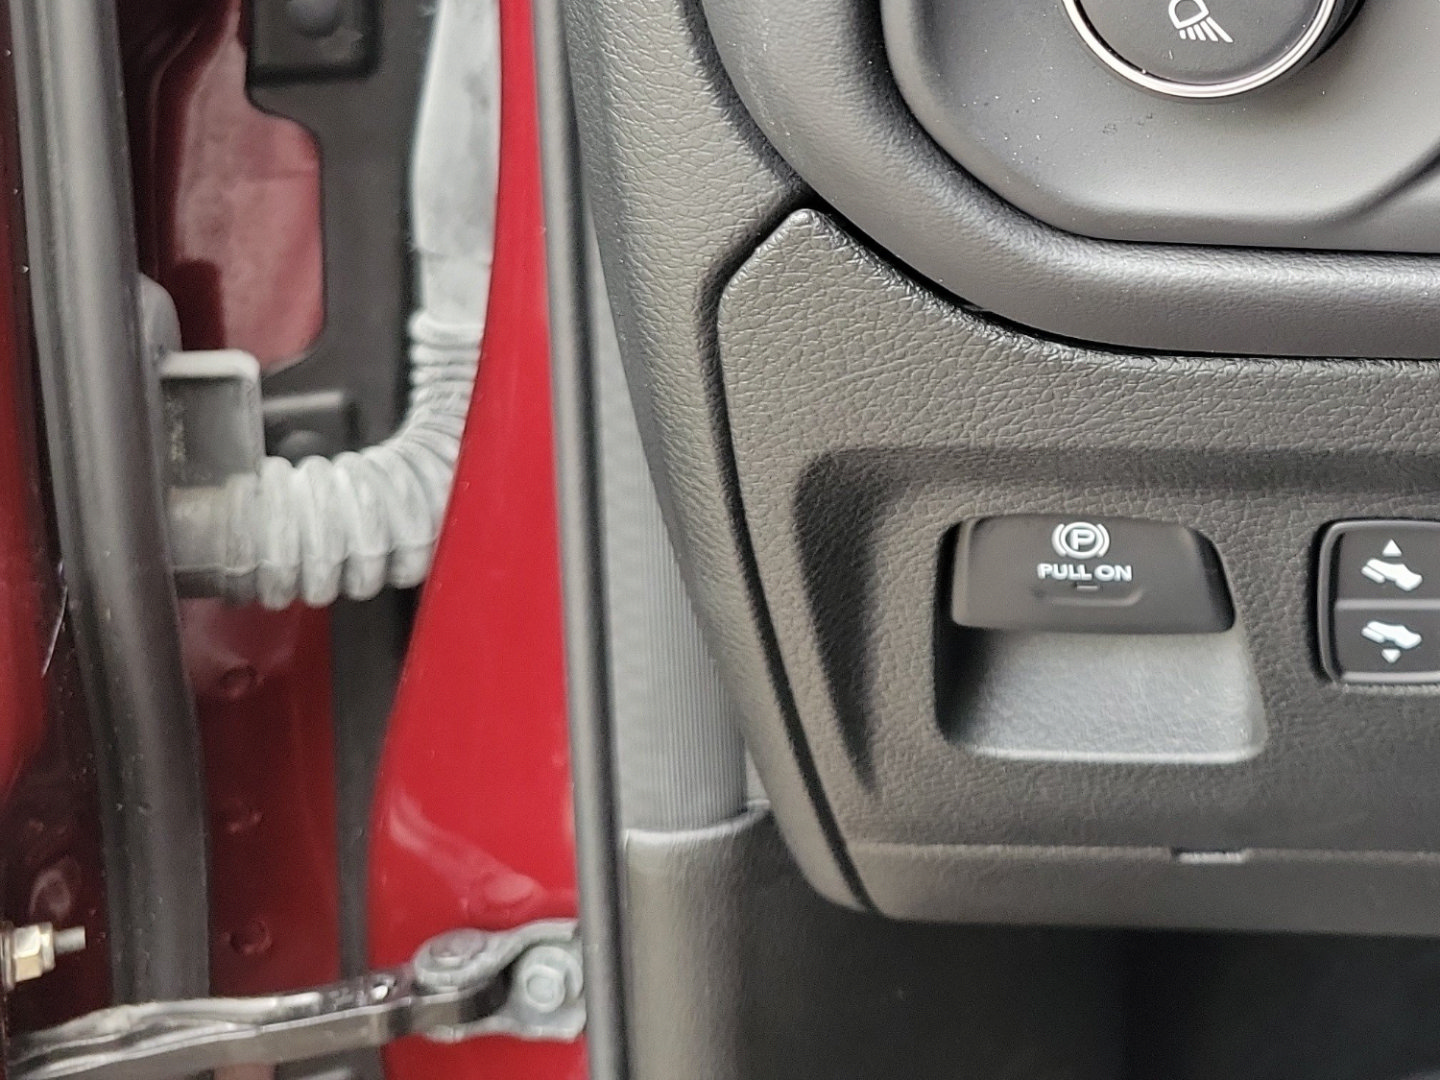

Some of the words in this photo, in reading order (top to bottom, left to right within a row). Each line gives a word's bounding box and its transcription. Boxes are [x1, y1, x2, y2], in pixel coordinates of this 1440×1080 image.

[1070, 529, 1095, 550] P
[1037, 563, 1092, 580] PULL
[1095, 564, 1132, 581] ON
